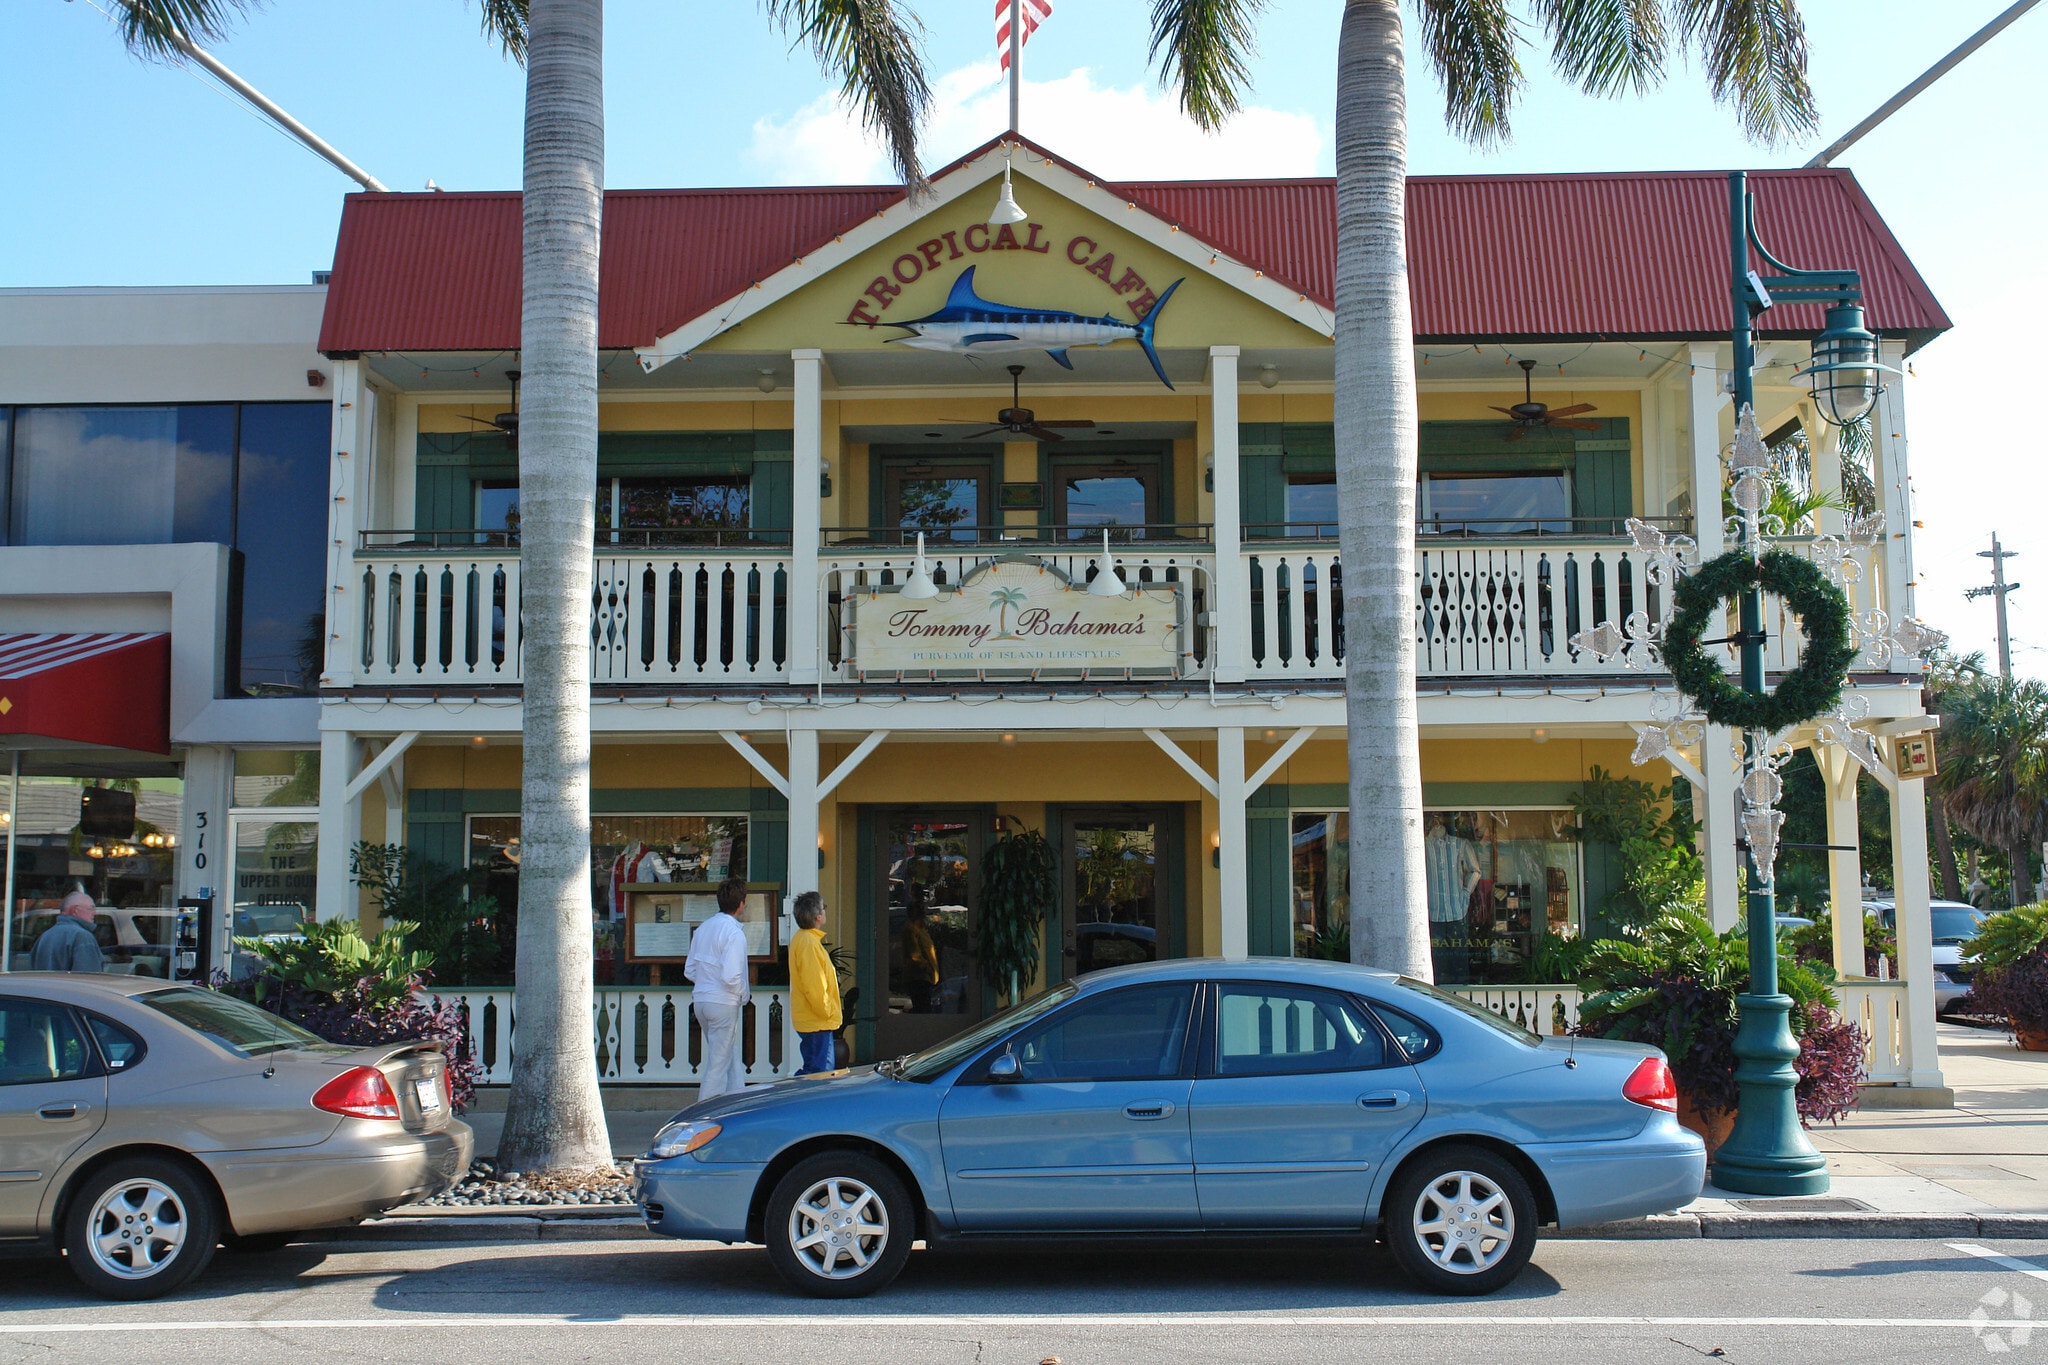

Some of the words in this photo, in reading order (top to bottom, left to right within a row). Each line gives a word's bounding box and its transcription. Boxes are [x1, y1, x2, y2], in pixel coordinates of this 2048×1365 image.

[847, 223, 1050, 329] TROPICAL
[888, 609, 991, 648] Tommy
[1015, 607, 1146, 636] Bahama's
[912, 651, 975, 661] PURVEYOR
[979, 651, 995, 660] OF
[999, 650, 1044, 660] ISLAND
[1049, 649, 1122, 660] LIFESTYLES
[196, 812, 207, 869] 310
[270, 856, 295, 869] THE
[241, 875, 279, 888] UPPER
[286, 875, 317, 888] COUR
